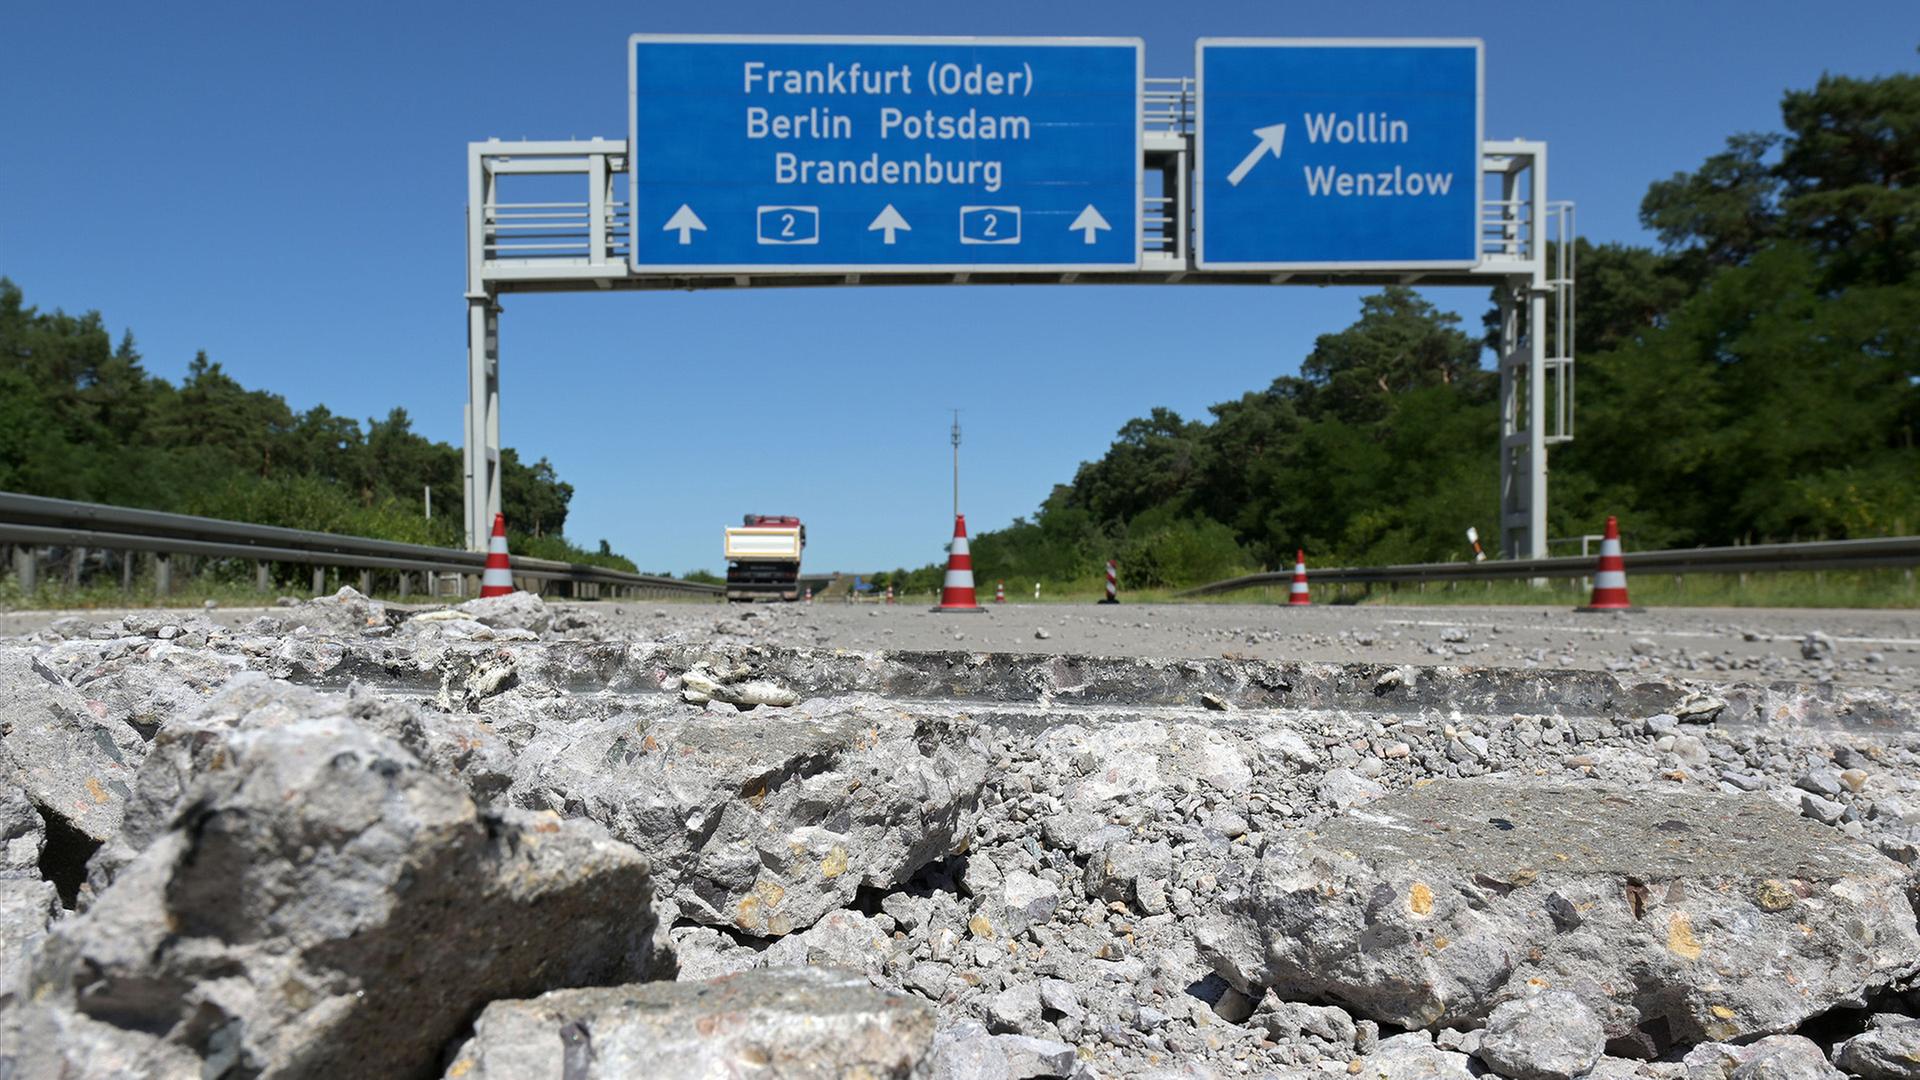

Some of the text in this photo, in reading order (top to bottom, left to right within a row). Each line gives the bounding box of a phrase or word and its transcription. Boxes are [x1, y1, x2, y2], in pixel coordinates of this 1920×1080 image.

[744, 62, 1033, 97] Frankfurt (Oder)
[747, 107, 1030, 139] Berlin Potsdam
[1304, 112, 1408, 143] Wollin
[775, 152, 1002, 192] Brandenburg
[1304, 165, 1453, 196] Wenzlow
[781, 213, 795, 237] 2
[984, 213, 997, 237] 2
